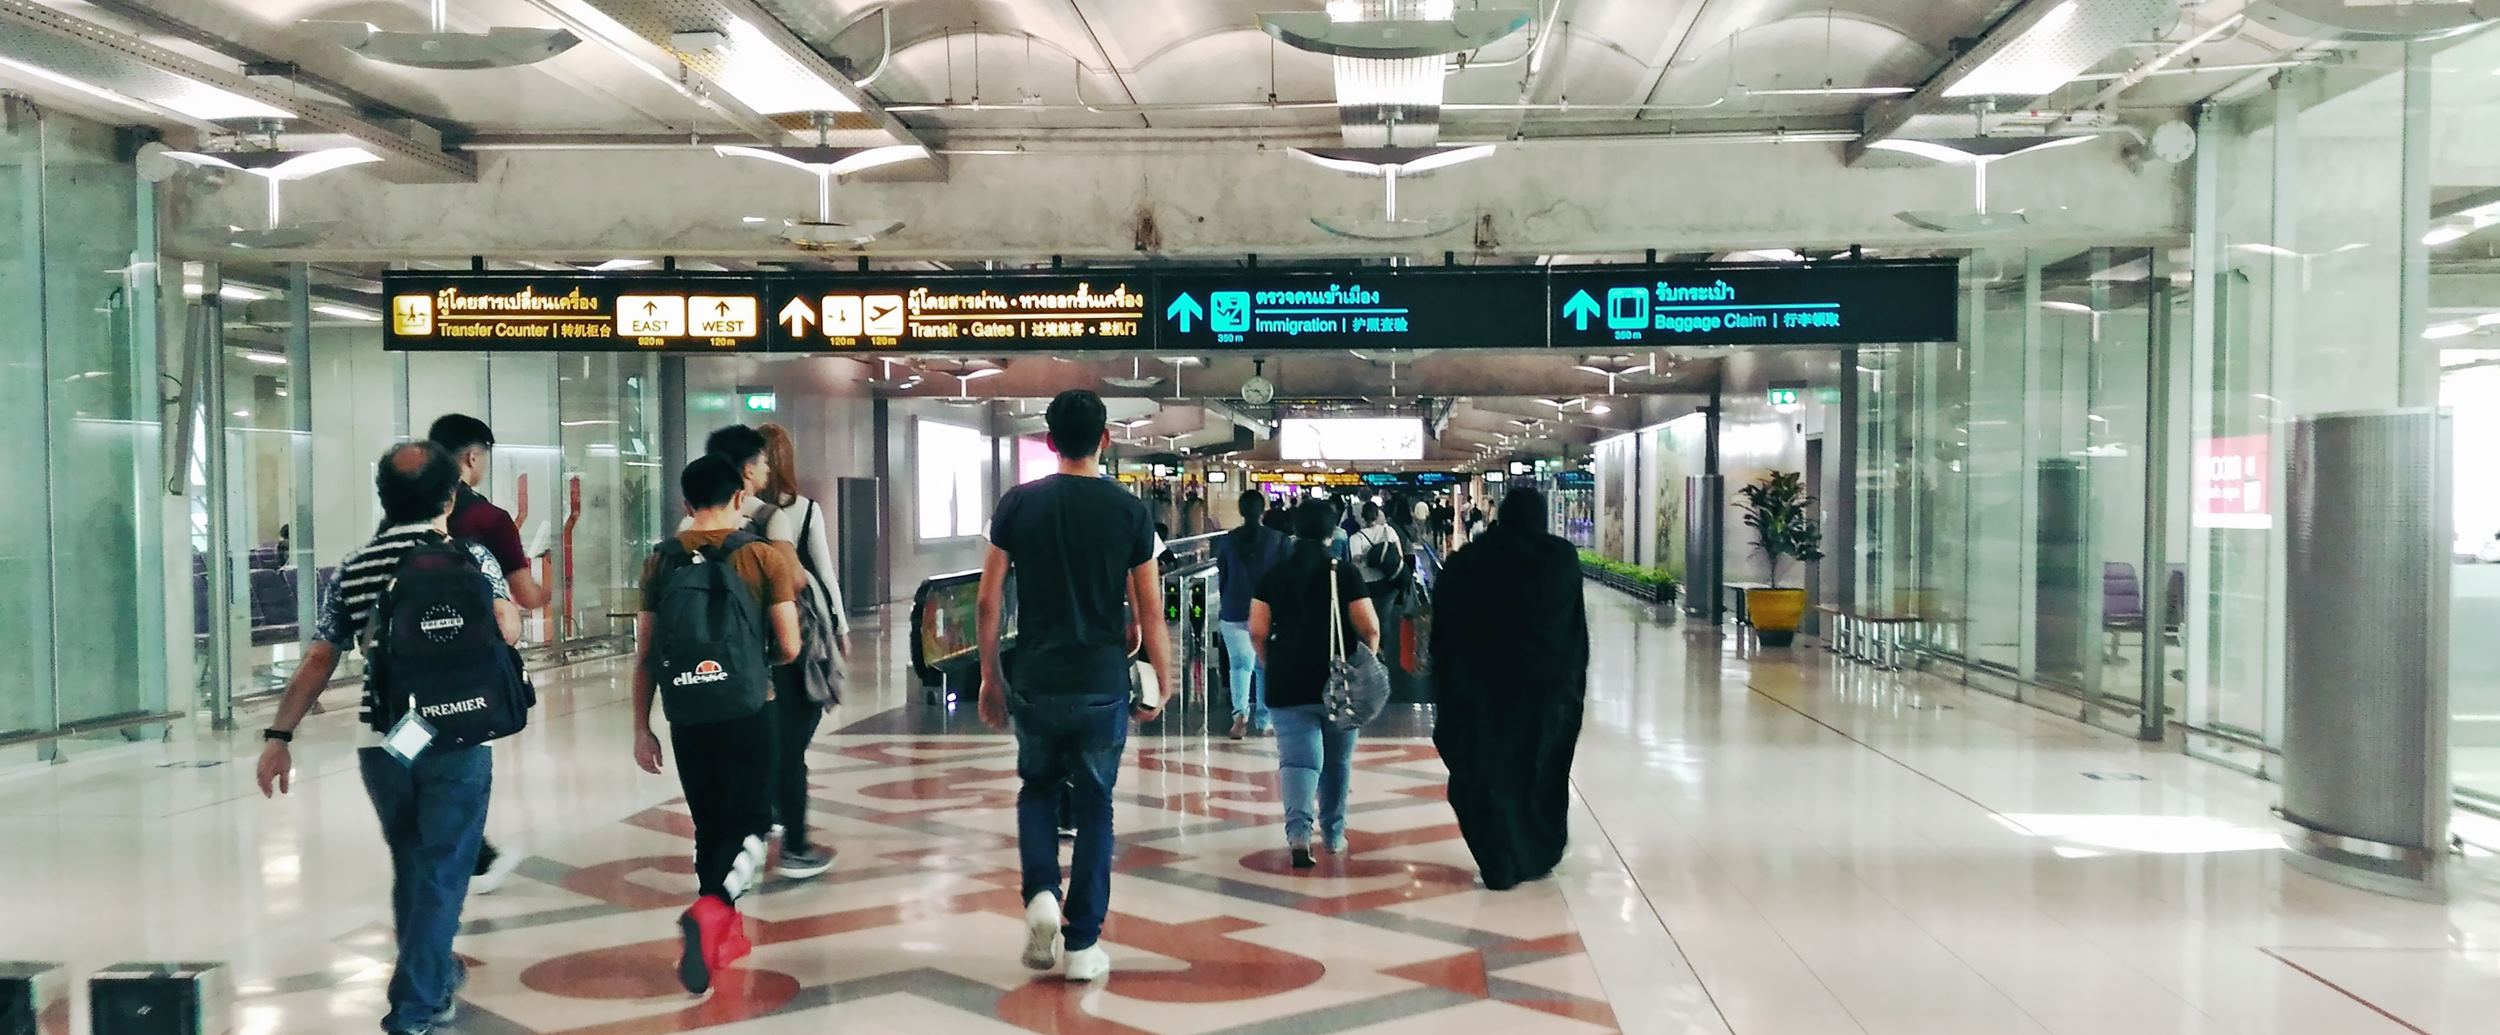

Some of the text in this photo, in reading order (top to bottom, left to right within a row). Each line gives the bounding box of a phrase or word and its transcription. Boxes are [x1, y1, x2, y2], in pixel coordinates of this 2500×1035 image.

[438, 322, 493, 337] Transfer
[495, 322, 549, 338] Counter
[632, 320, 669, 332] EAST
[702, 320, 744, 333] WEST
[908, 322, 958, 338] Transit
[971, 321, 1015, 337] Gates
[1256, 317, 1338, 335] Immigration
[1655, 314, 1721, 332] Baggage
[1724, 312, 1767, 328] Claim
[673, 671, 729, 687] ellesse
[421, 697, 488, 718] PREMIER
